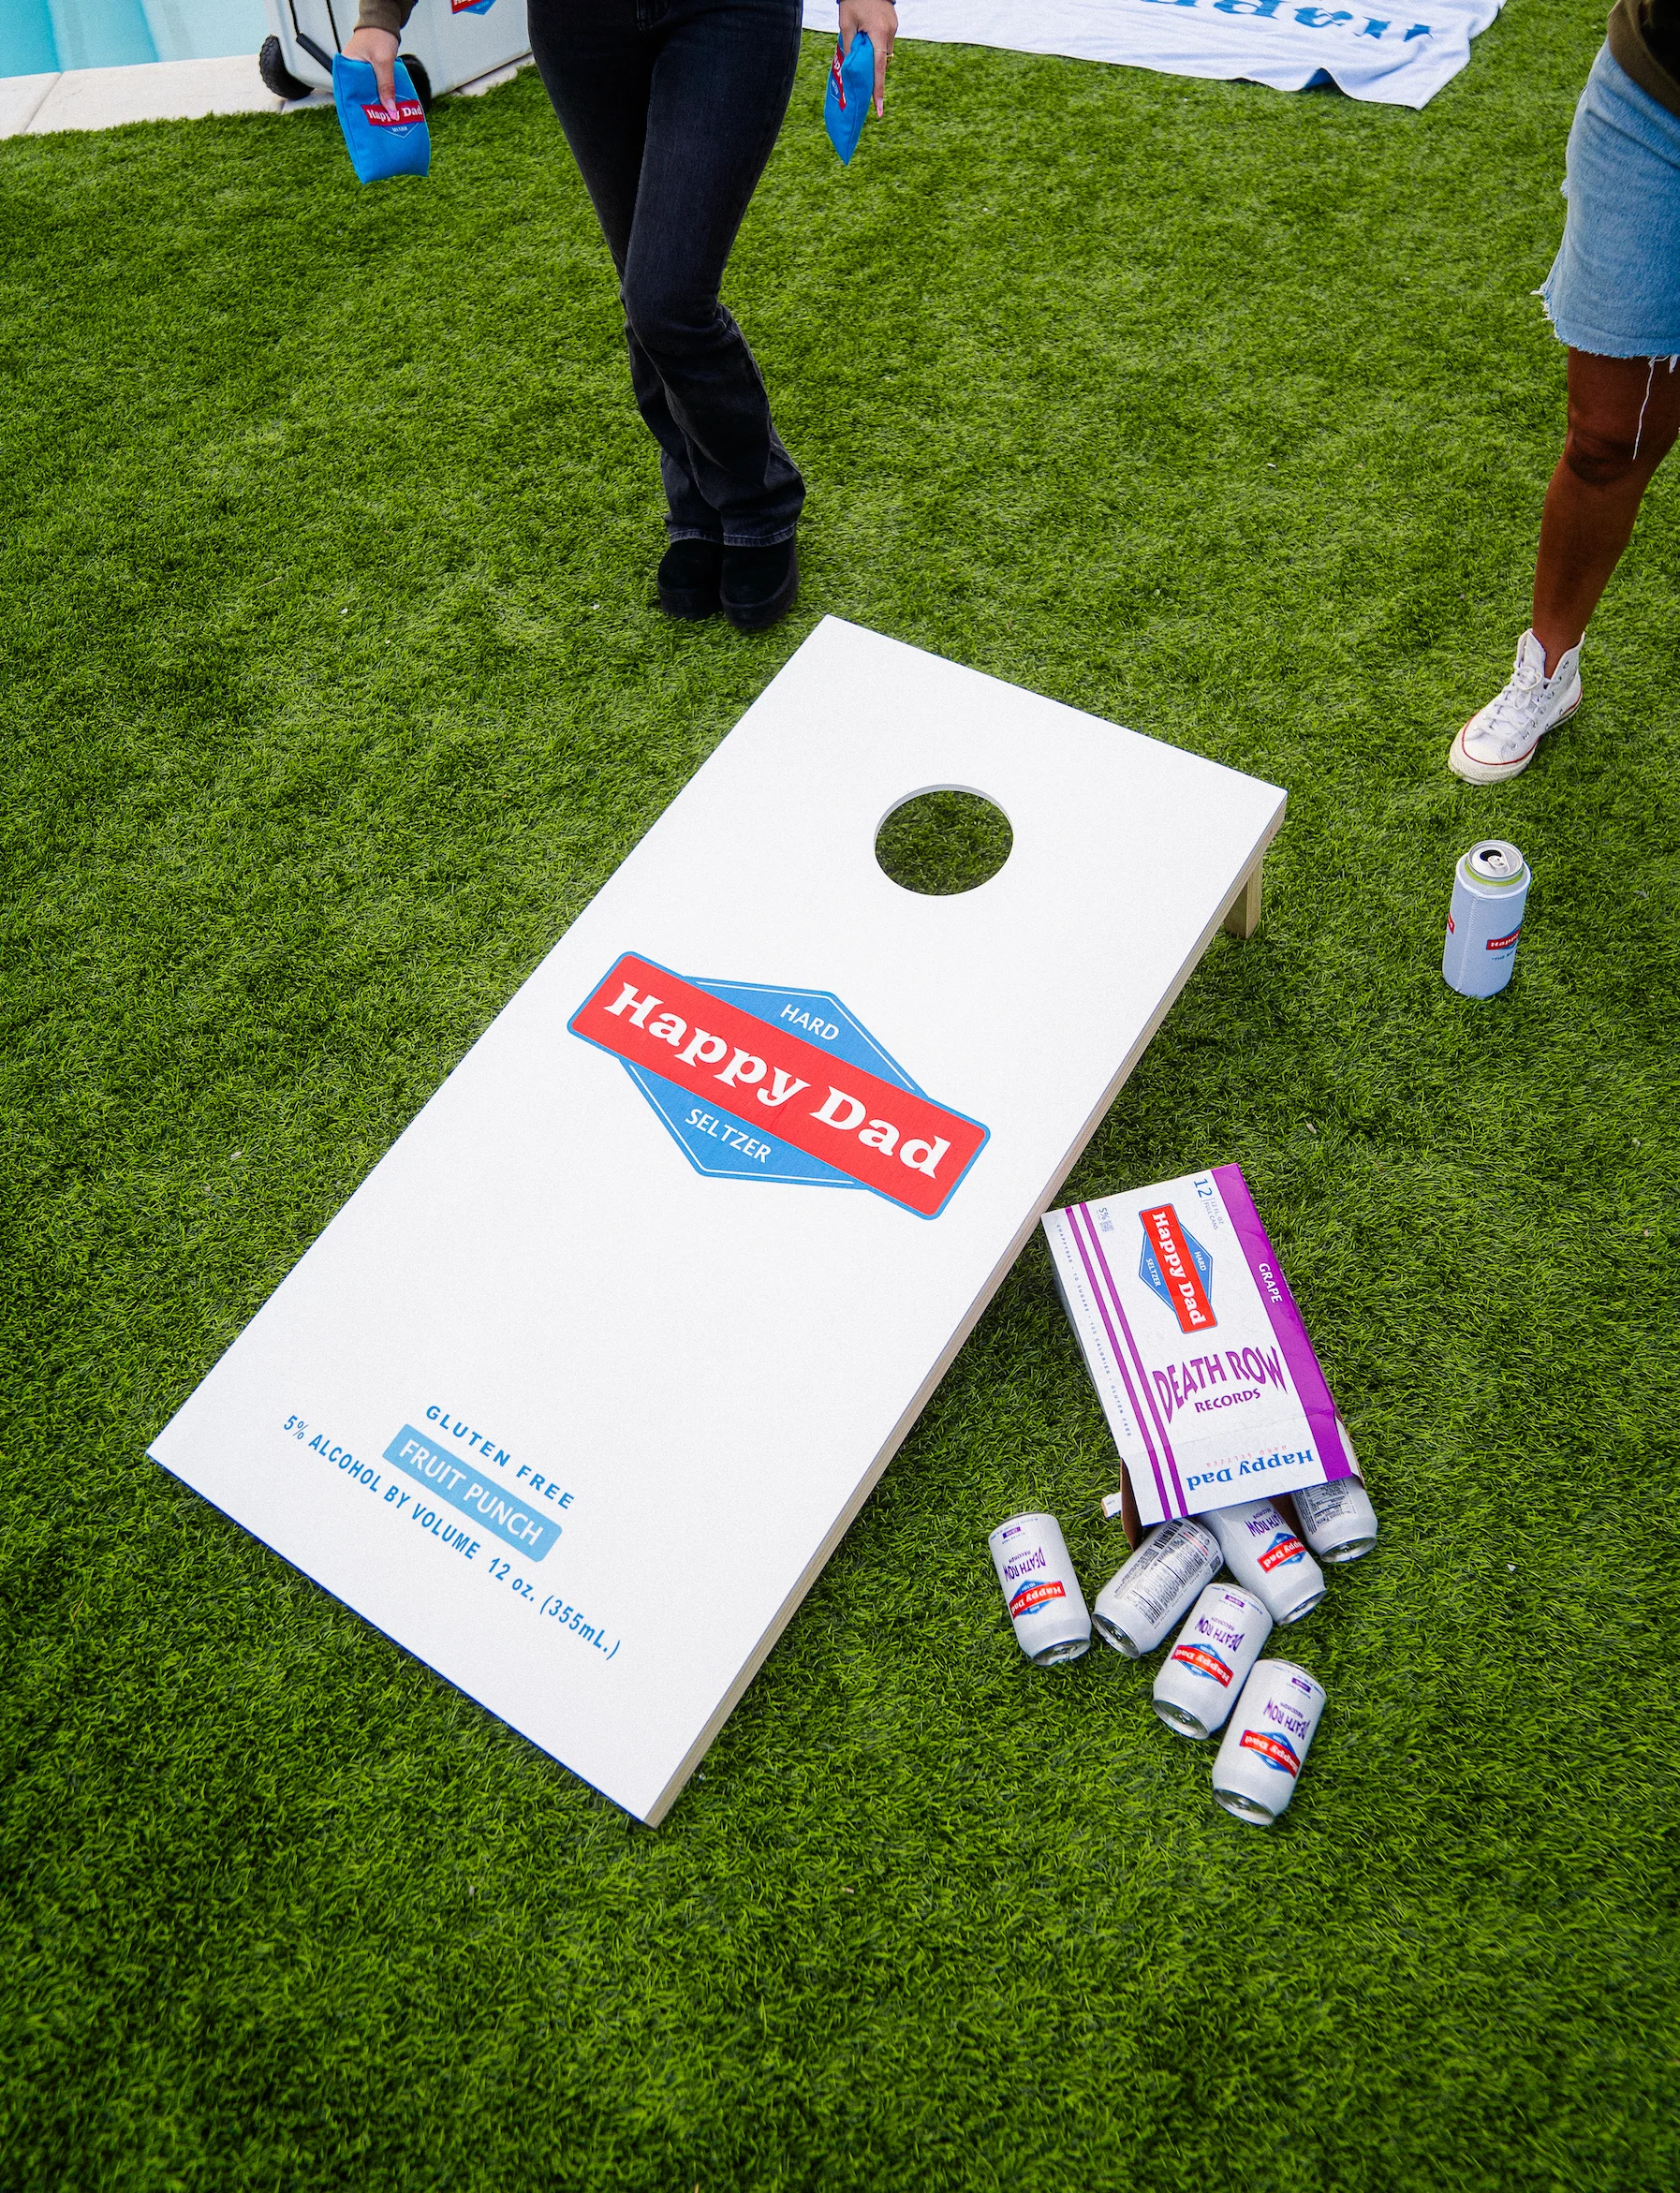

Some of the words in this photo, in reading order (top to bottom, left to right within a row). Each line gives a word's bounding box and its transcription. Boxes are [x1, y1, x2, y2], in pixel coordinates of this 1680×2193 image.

[401, 104, 423, 117] Dad
[780, 1003, 840, 1041] HARD
[603, 981, 811, 1107] Happy
[809, 1085, 951, 1180] Dad
[685, 1108, 773, 1164] SELTZER
[1193, 1178, 1213, 1199] 12
[1098, 1207, 1110, 1220] 5%
[1209, 1215, 1218, 1229] CANS
[1145, 1258, 1161, 1288] SELTZER
[1152, 1211, 1186, 1279] Happy
[1178, 1280, 1207, 1326] Dad
[1194, 1251, 1207, 1272] HARD
[1259, 1262, 1283, 1303] GRAPE
[1095, 1337, 1111, 1374] CALORIES
[1111, 1385, 1123, 1414] GLUTEN
[1123, 1418, 1131, 1436] FREE
[1152, 1354, 1227, 1424] DEATH
[1225, 1346, 1288, 1394] ROW
[1194, 1388, 1261, 1413] RECORDS
[426, 1406, 510, 1467] GLUTEN
[516, 1464, 575, 1509] FREE
[1206, 1453, 1252, 1467] SELTZER
[1260, 1445, 1287, 1455] HARD
[1239, 1450, 1314, 1476] Happy
[1186, 1467, 1233, 1491] Dad
[399, 1438, 467, 1491] FRUIT
[464, 1482, 544, 1547] PUNCH
[283, 1415, 309, 1440] 5%
[309, 1434, 380, 1493] ALCOHOL
[384, 1485, 411, 1509] BY
[411, 1503, 480, 1560] VOLUME
[488, 1557, 510, 1582] 12
[511, 1578, 536, 1601] oz.
[539, 1595, 622, 1660] (355mL.)
[1244, 1520, 1271, 1538] ROW
[1020, 1546, 1046, 1575] DEATH
[1262, 1550, 1284, 1568] Dad
[1010, 1597, 1025, 1614] Dad
[1026, 1585, 1062, 1602] Happy
[1194, 1613, 1215, 1637] ROW
[1213, 1628, 1245, 1652] DEATH
[1174, 1649, 1195, 1660] Dad
[1198, 1655, 1231, 1683] Happy
[1263, 1696, 1285, 1725] ROW
[1245, 1735, 1269, 1750] Dad
